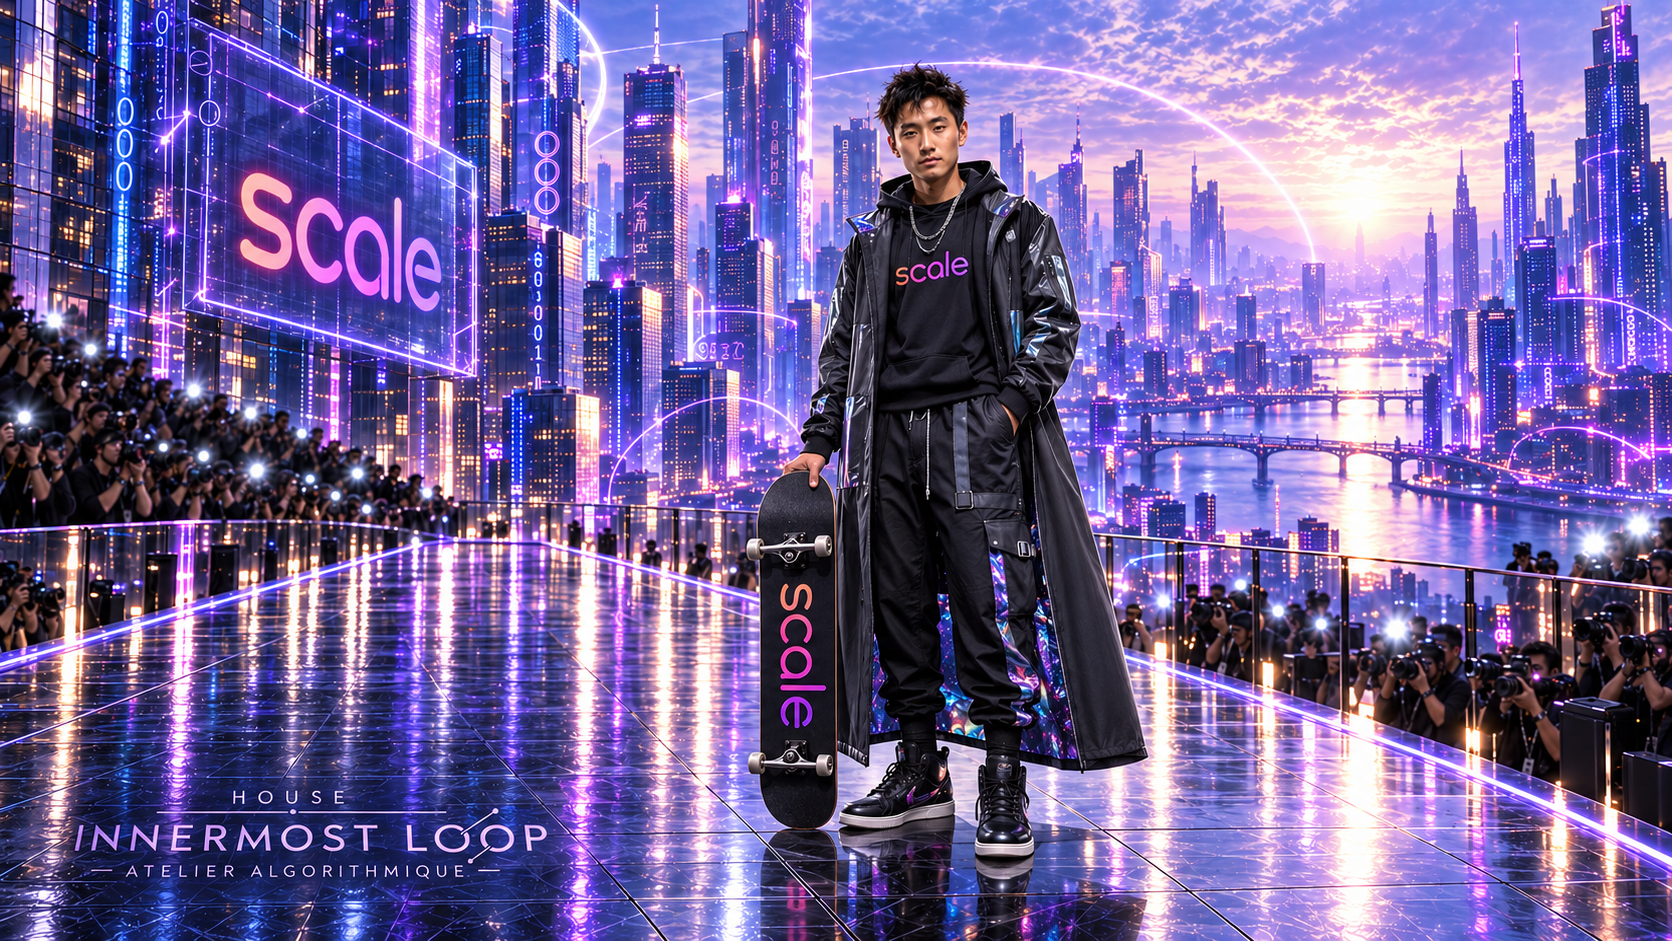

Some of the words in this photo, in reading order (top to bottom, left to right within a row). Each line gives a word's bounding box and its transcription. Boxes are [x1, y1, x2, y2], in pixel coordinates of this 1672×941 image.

[240, 172, 442, 312] scale
[895, 250, 969, 286] scale
[780, 583, 827, 729] scale
